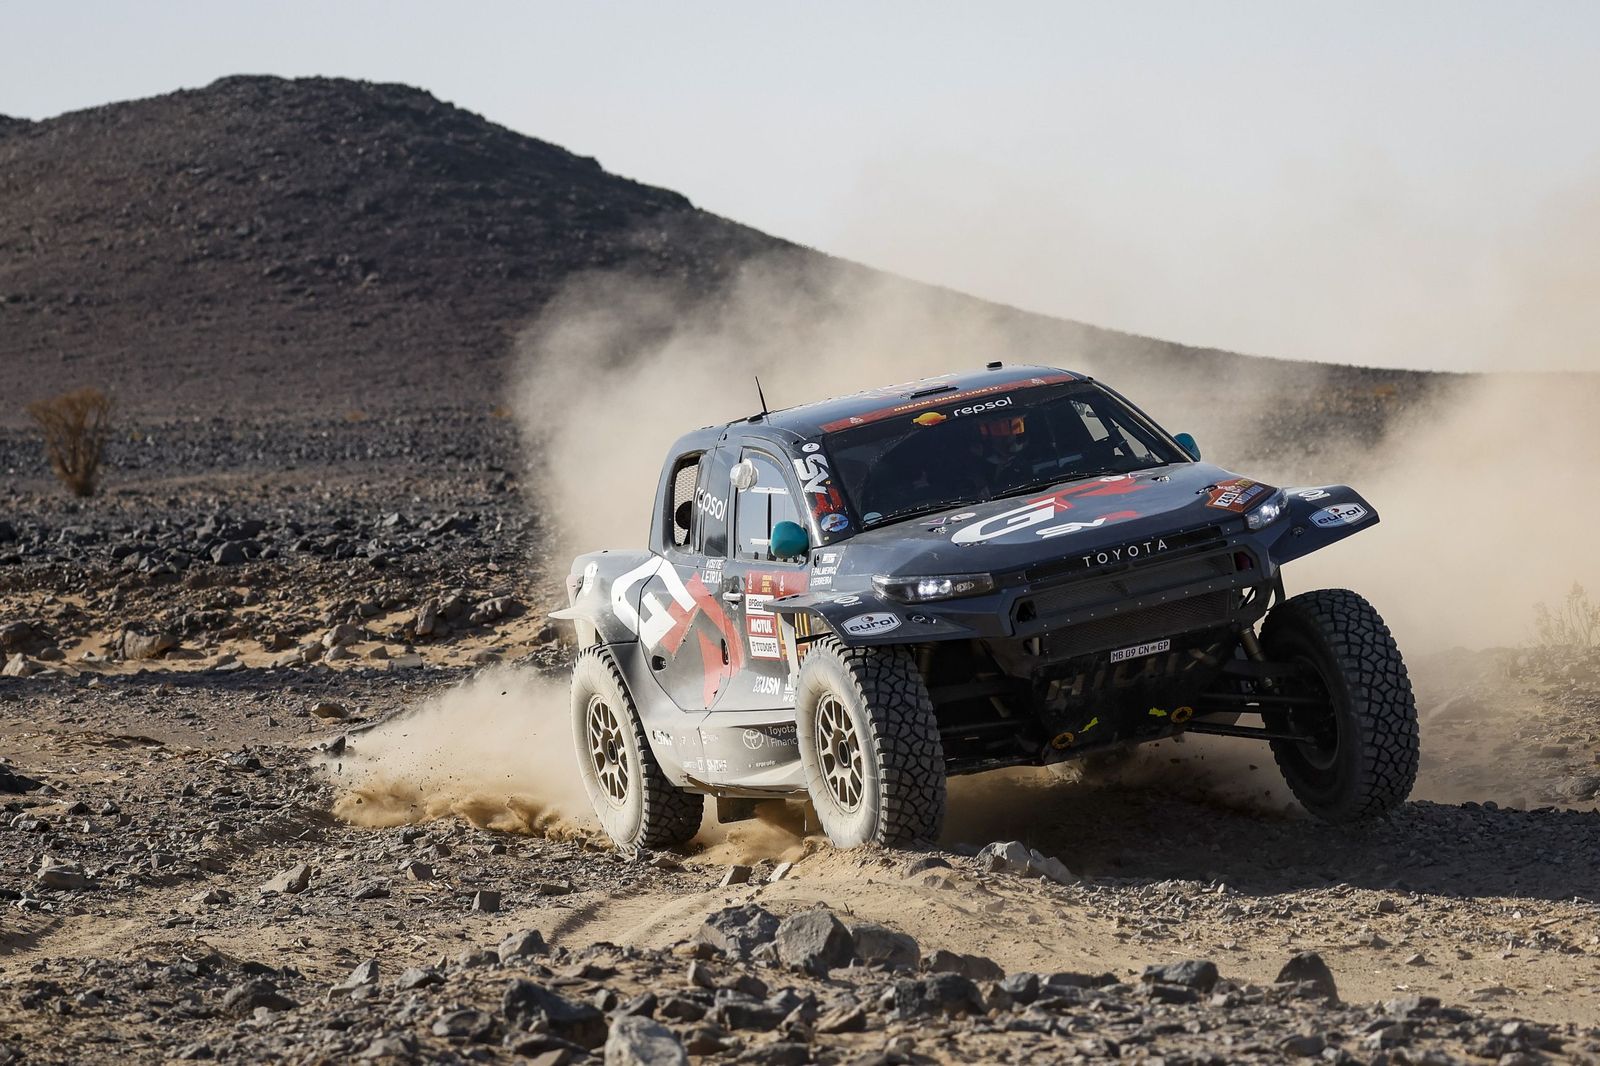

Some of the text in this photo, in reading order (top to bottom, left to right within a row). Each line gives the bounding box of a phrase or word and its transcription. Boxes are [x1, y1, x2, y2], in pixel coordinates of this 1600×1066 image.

[953, 396, 1013, 417] repsol
[695, 486, 728, 522] repsol
[1318, 506, 1362, 524] eurol
[1082, 538, 1168, 568] TOYOTA
[751, 618, 772, 634] MOTUL
[849, 616, 895, 632] eurol
[1112, 641, 1169, 661] MB 09 CN GP
[761, 675, 781, 695] USN
[768, 725, 796, 736] Toyota
